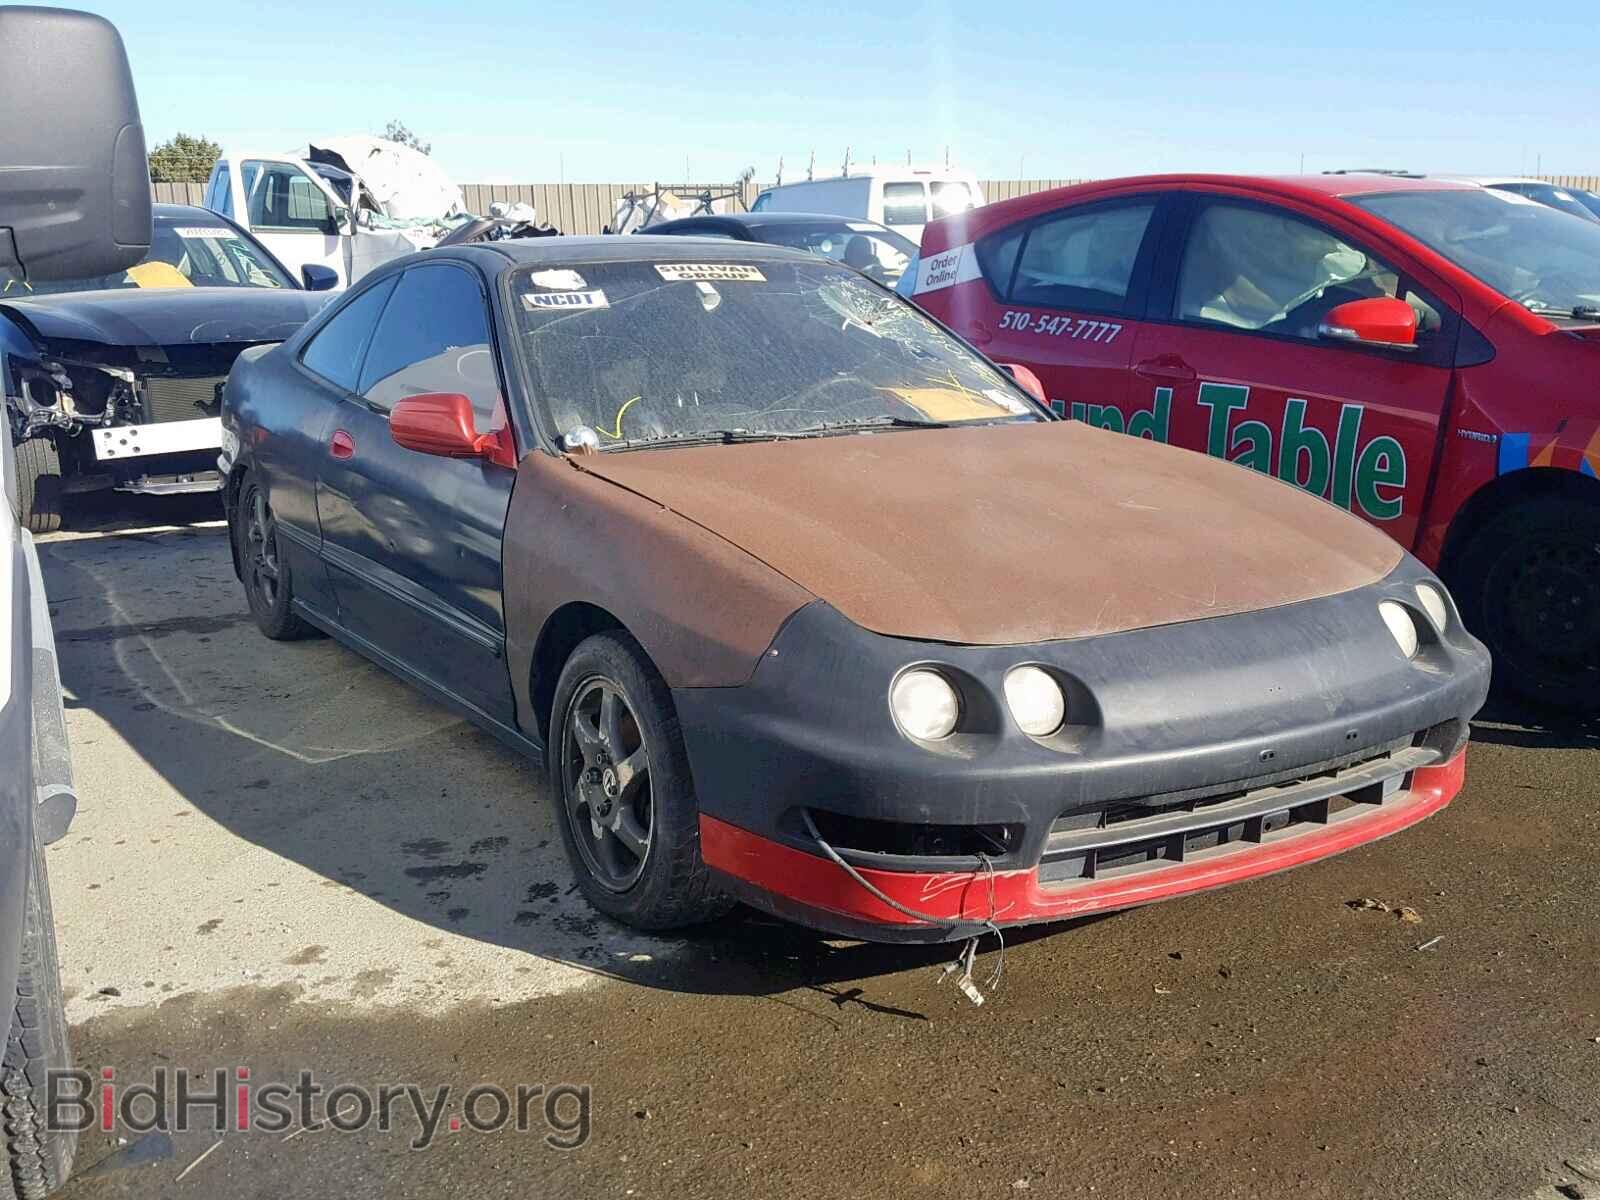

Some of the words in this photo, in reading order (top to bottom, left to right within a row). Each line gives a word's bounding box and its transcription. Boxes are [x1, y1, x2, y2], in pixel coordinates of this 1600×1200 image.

[658, 265, 758, 274] SULLIVAN
[930, 255, 958, 271] Order
[678, 272, 751, 280] GROUP
[926, 270, 957, 286] Online
[999, 310, 1122, 344] 510-547-7777
[1197, 381, 1407, 520] Table
